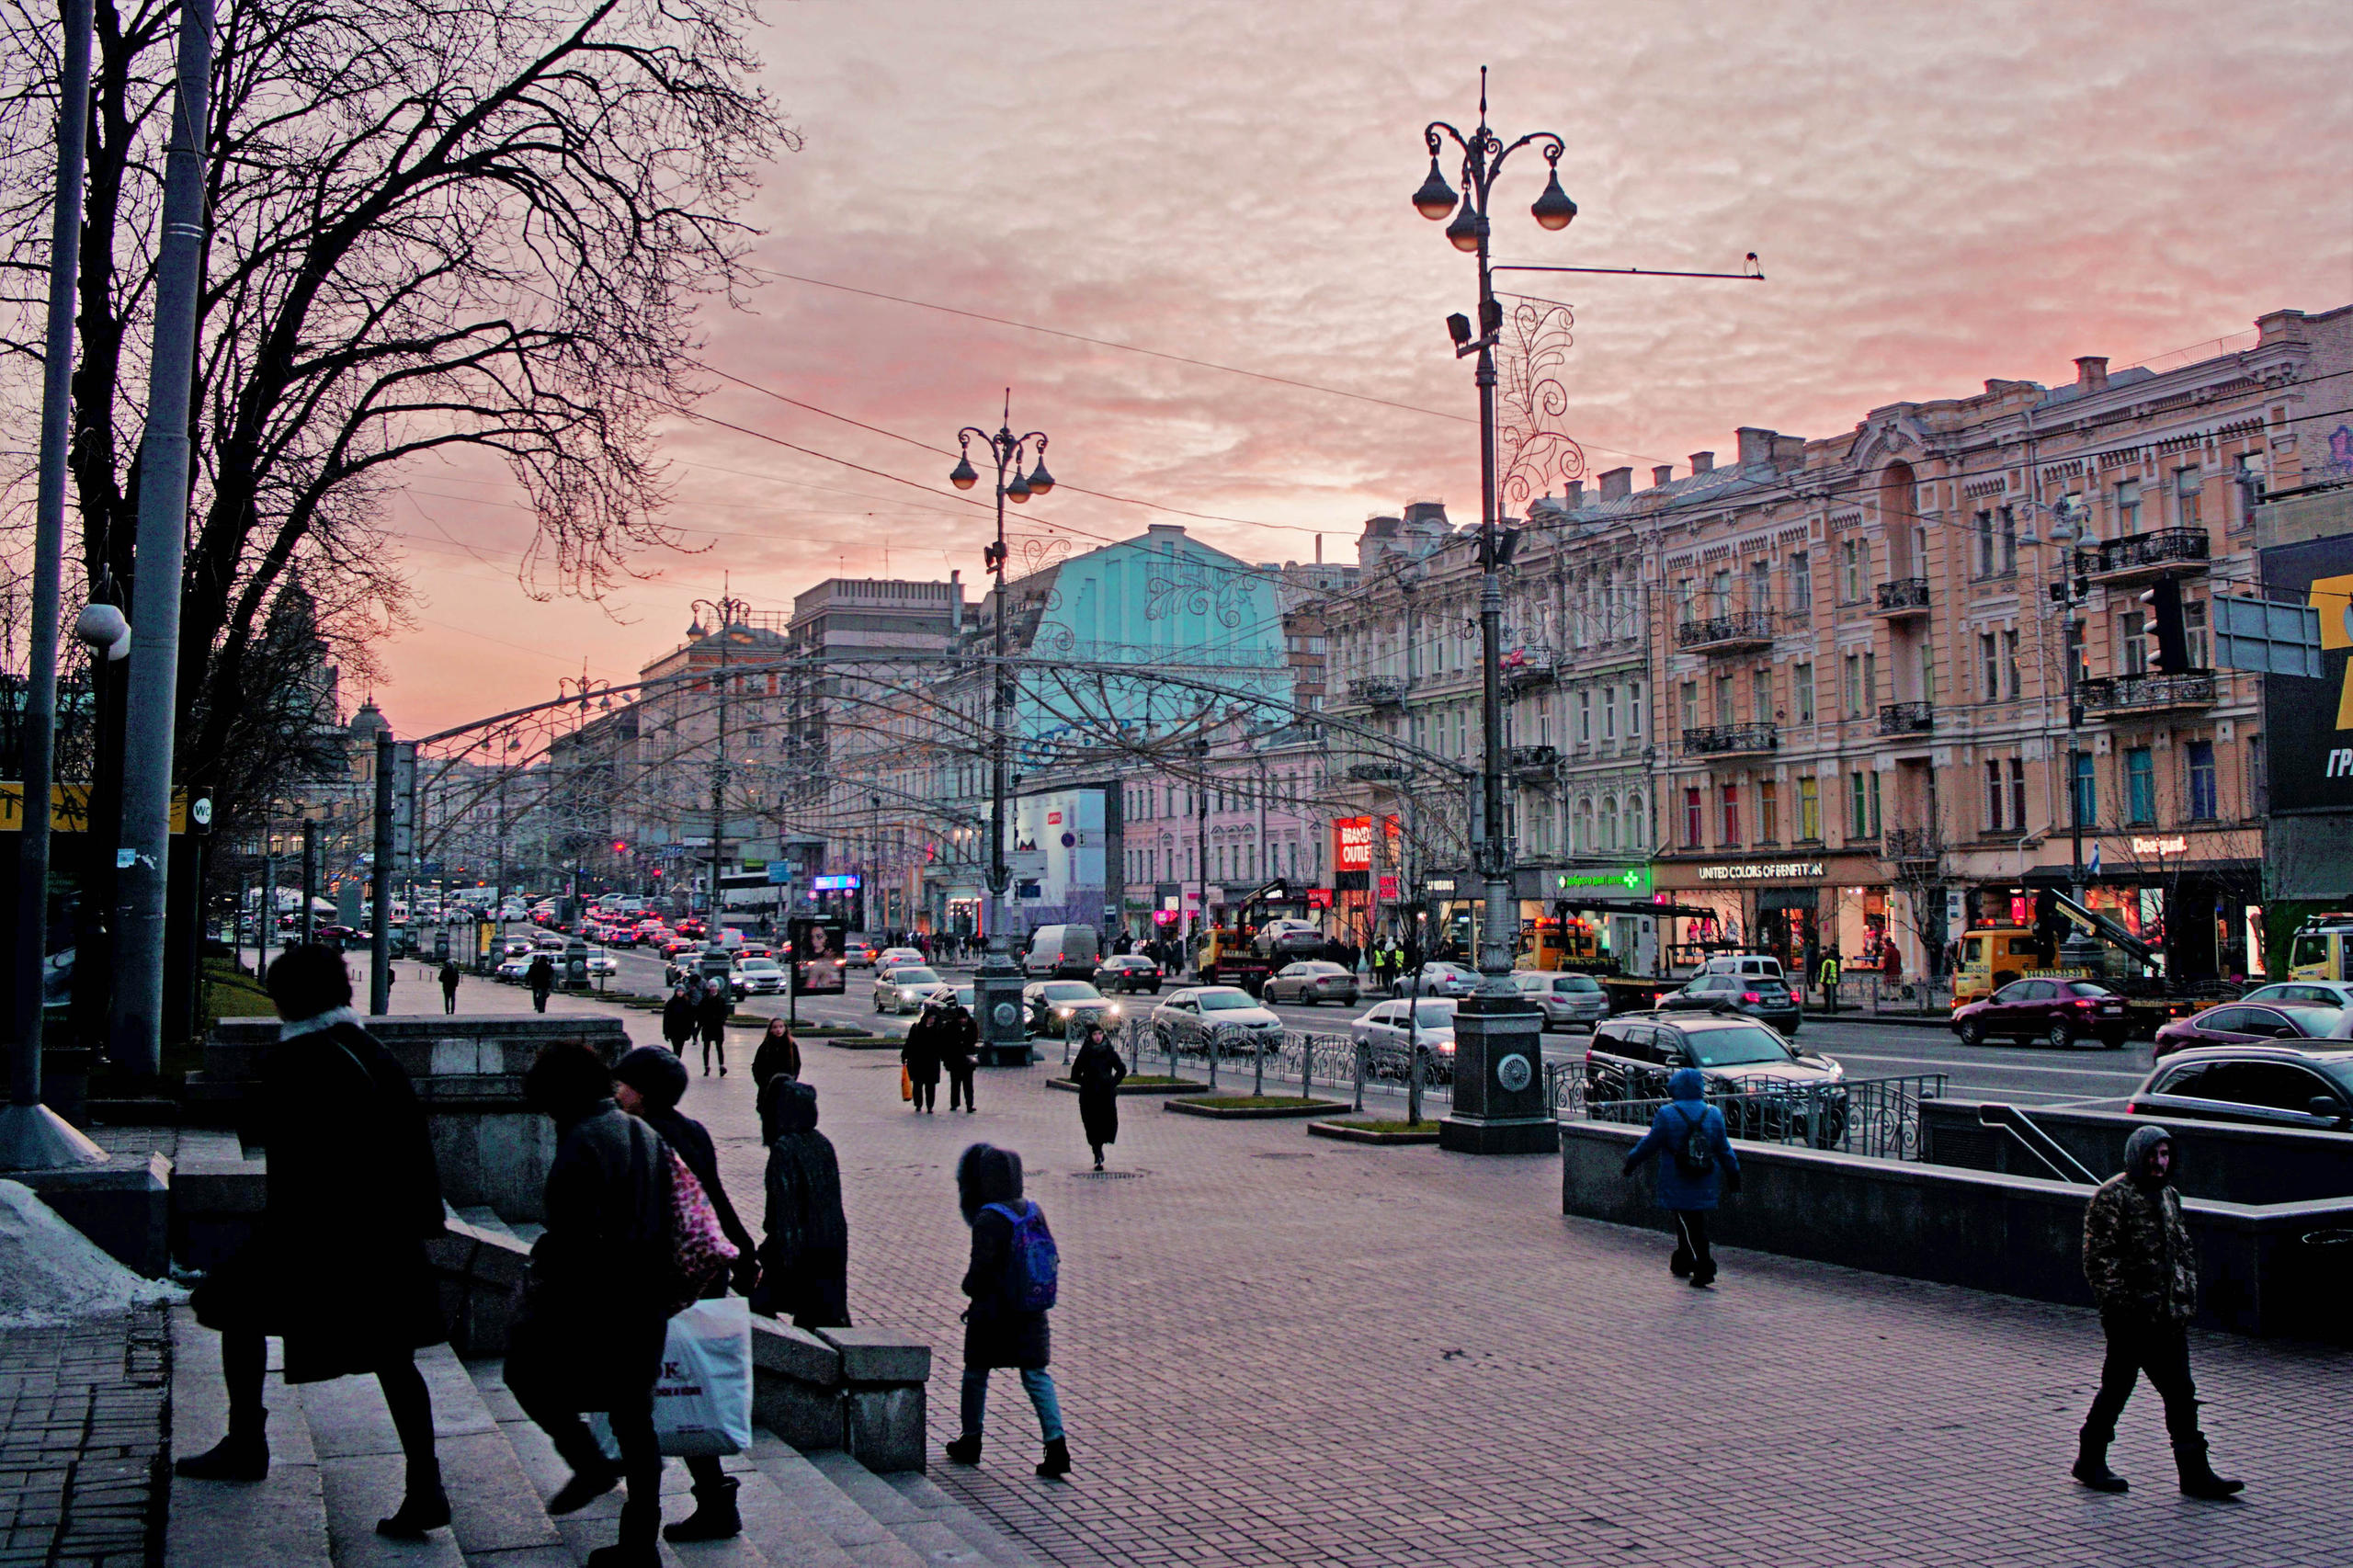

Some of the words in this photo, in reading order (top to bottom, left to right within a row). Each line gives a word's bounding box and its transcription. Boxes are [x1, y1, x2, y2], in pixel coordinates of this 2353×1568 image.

[2326, 748, 2353, 778] ГР
[195, 805, 210, 816] WC
[1699, 866, 1729, 880] UNITED
[1729, 865, 1762, 879] COLORS
[1762, 864, 1775, 878] OF
[1775, 862, 1824, 878] BENETTON
